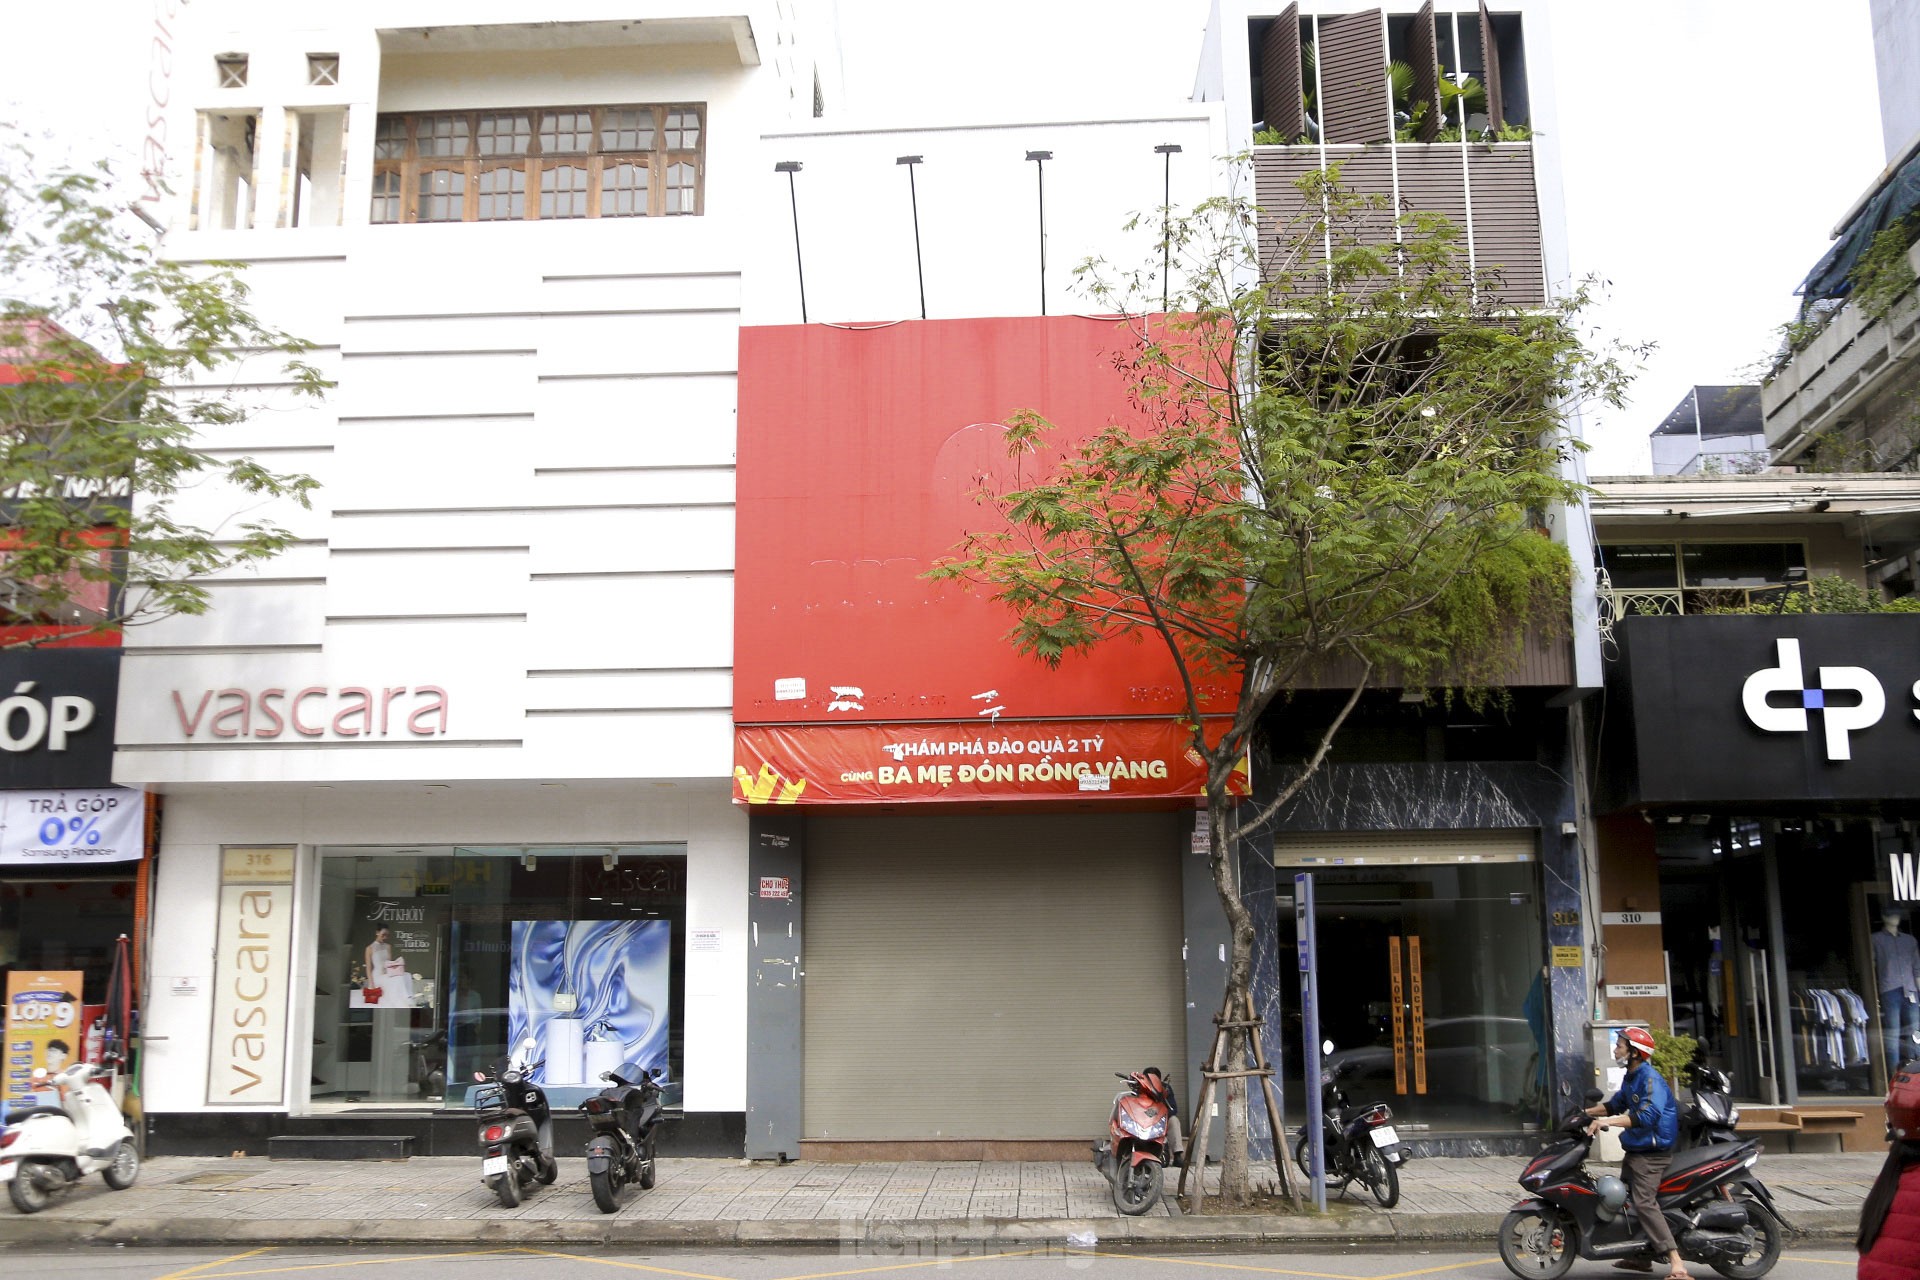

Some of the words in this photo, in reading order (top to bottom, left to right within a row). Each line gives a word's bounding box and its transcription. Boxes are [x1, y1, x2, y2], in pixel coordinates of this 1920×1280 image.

[0, 681, 96, 752] ÓP
[171, 684, 449, 737] vascara
[893, 738, 945, 756] KHÁM
[948, 737, 985, 755] PHÁ
[987, 736, 1025, 754] ĐẢO
[1027, 735, 1065, 755] QUÀ
[1067, 739, 1079, 753] 2
[1081, 734, 1105, 753] TỶ
[840, 770, 874, 783] CÙNG
[878, 766, 913, 785] BA
[917, 764, 953, 788] MẸ
[957, 758, 1014, 784] ĐÓN
[1018, 754, 1091, 782] RỒNG
[1095, 755, 1168, 780] VÀNG
[28, 791, 68, 813] TRẢ
[75, 793, 118, 813] GÓP
[39, 816, 101, 846] 0%
[22, 848, 69, 859] Samsung
[246, 854, 273, 865] 316
[1621, 913, 1642, 924] 310
[229, 889, 273, 1096] vascara
[52, 1001, 75, 1028] 9
